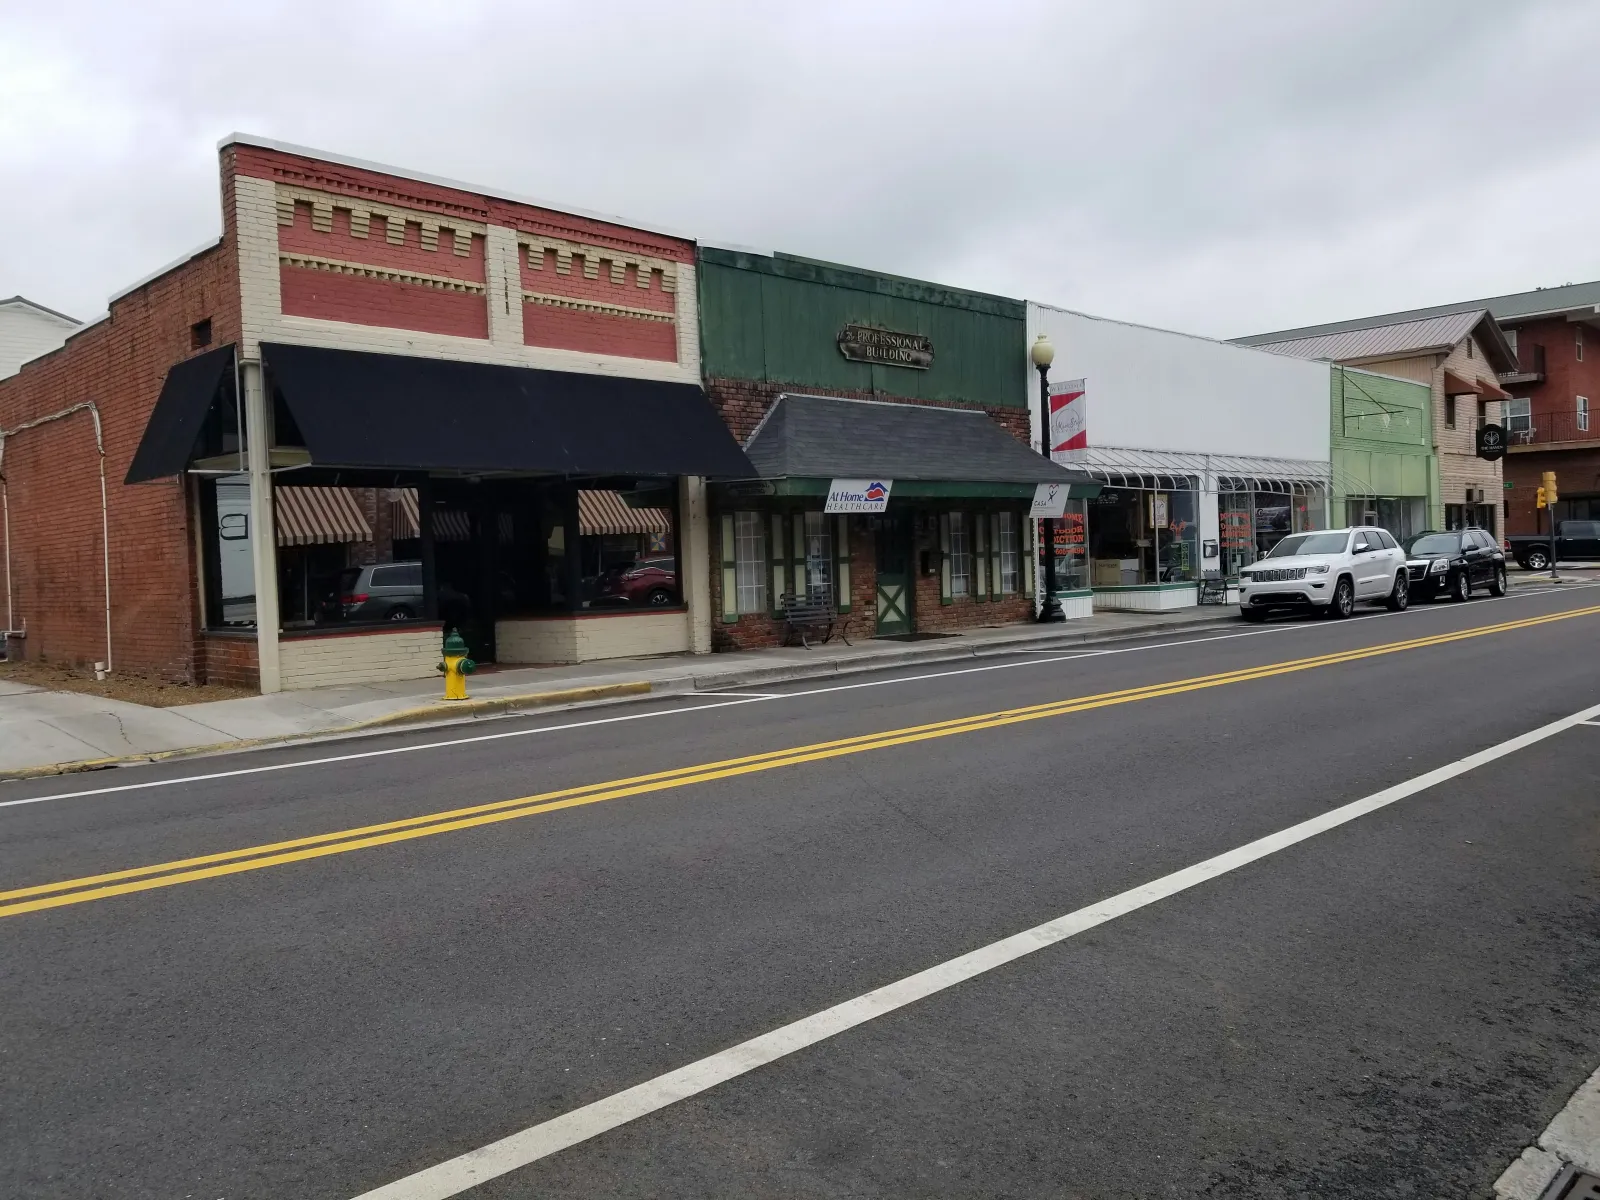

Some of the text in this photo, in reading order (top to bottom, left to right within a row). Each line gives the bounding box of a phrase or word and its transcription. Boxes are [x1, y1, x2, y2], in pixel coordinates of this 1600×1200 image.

[857, 330, 926, 351] PROFESSIONAL
[866, 345, 912, 362] BUILDING
[829, 491, 864, 502] At Home
[826, 502, 885, 511] HEALTHCARE
